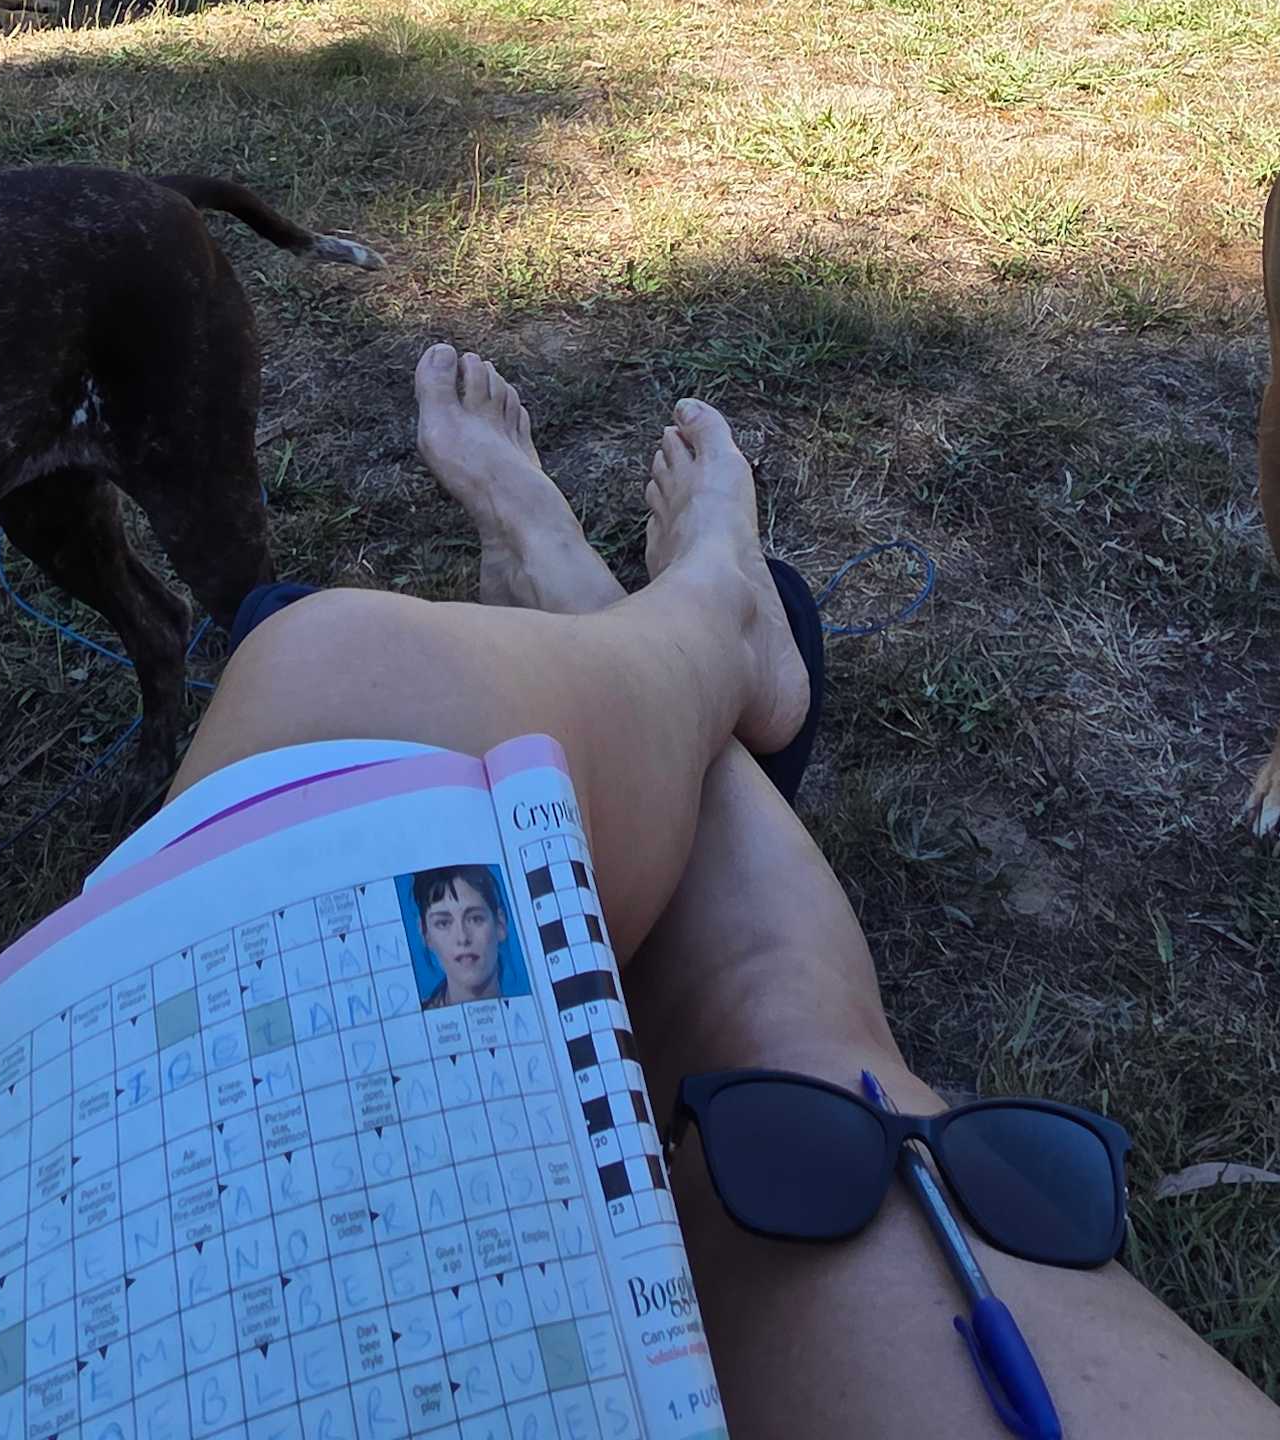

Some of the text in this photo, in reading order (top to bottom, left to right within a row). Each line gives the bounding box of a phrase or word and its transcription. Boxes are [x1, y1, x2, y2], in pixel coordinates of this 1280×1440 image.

[594, 1136, 608, 1150] 20
[611, 1203, 625, 1216] 23
[641, 1329, 665, 1347] Can
[666, 1326, 685, 1343] you
[669, 1400, 682, 1421] 1.
